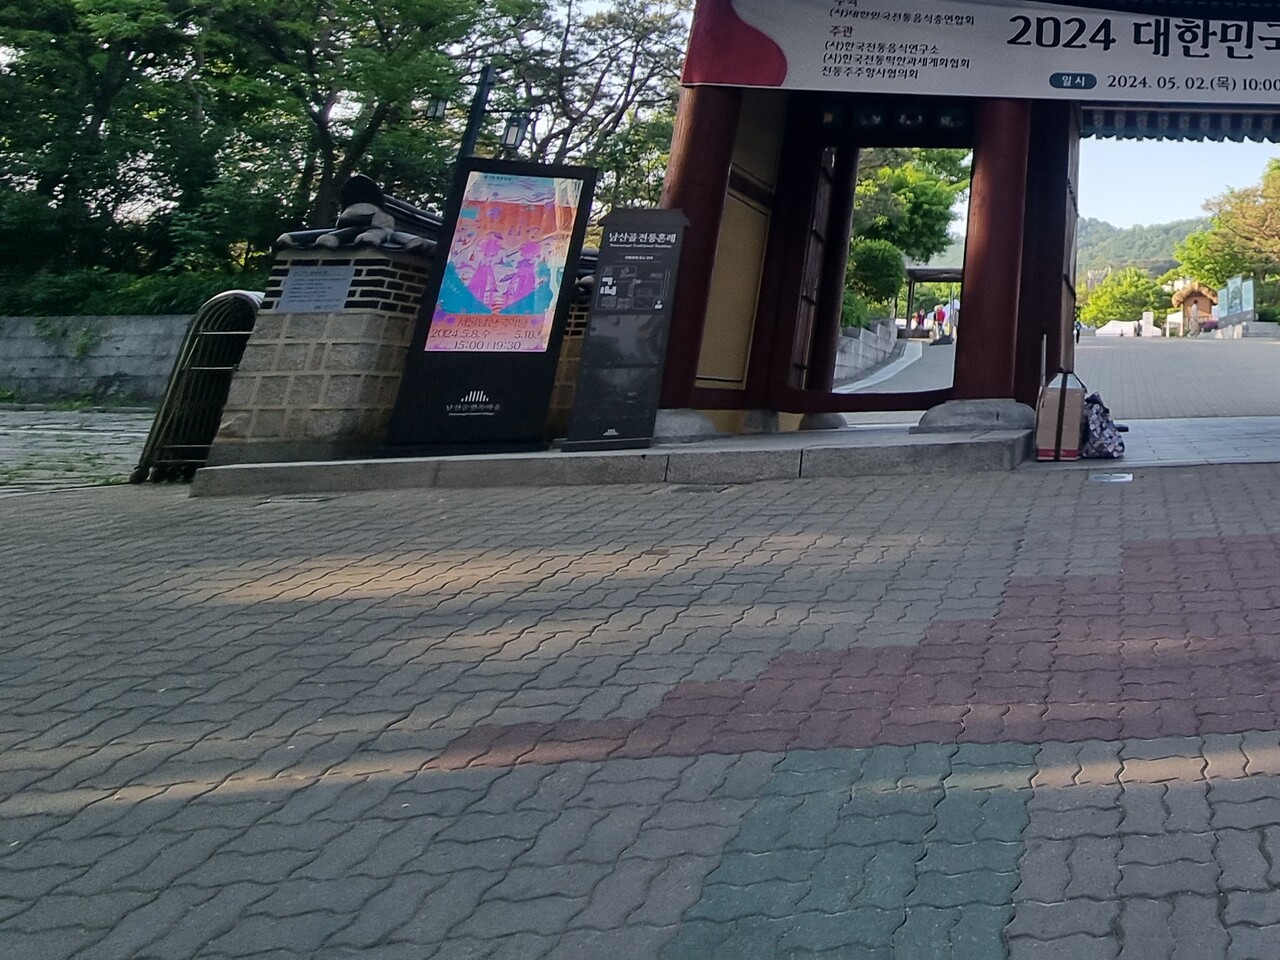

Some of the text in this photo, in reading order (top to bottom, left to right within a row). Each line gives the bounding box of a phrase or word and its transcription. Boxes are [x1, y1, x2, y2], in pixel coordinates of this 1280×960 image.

[829, 25, 854, 38] 주관
[1006, 15, 1117, 51] 2024
[1107, 75, 1152, 89] 2024.
[1157, 75, 1181, 89] 05.
[454, 341, 521, 350] 15:00 19:30
